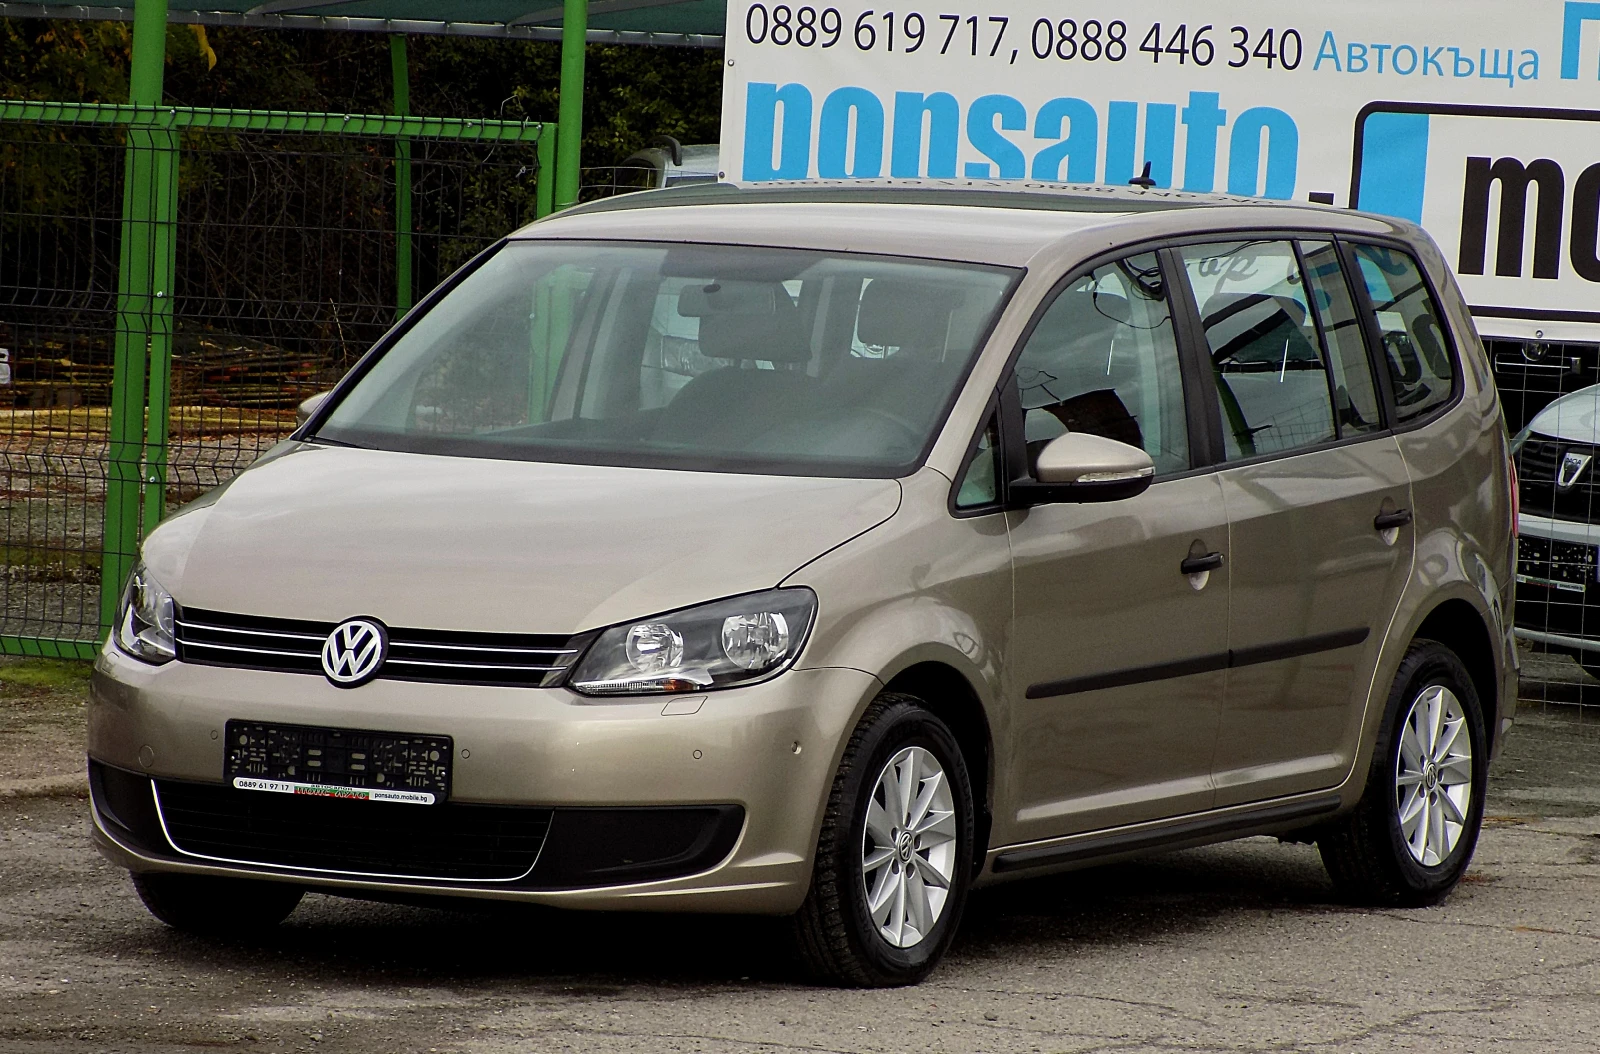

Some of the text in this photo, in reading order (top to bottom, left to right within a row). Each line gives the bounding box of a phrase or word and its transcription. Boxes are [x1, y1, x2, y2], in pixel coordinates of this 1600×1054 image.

[745, 4, 842, 49] 0889
[854, 10, 926, 54] 619
[940, 14, 1019, 64] 717,
[1031, 17, 1127, 62] 0888
[1138, 22, 1215, 67] 446
[1228, 26, 1303, 71] 340
[1313, 30, 1540, 88] Автокъща
[741, 81, 1300, 200] ponsauto
[258, 781, 267, 789] 61
